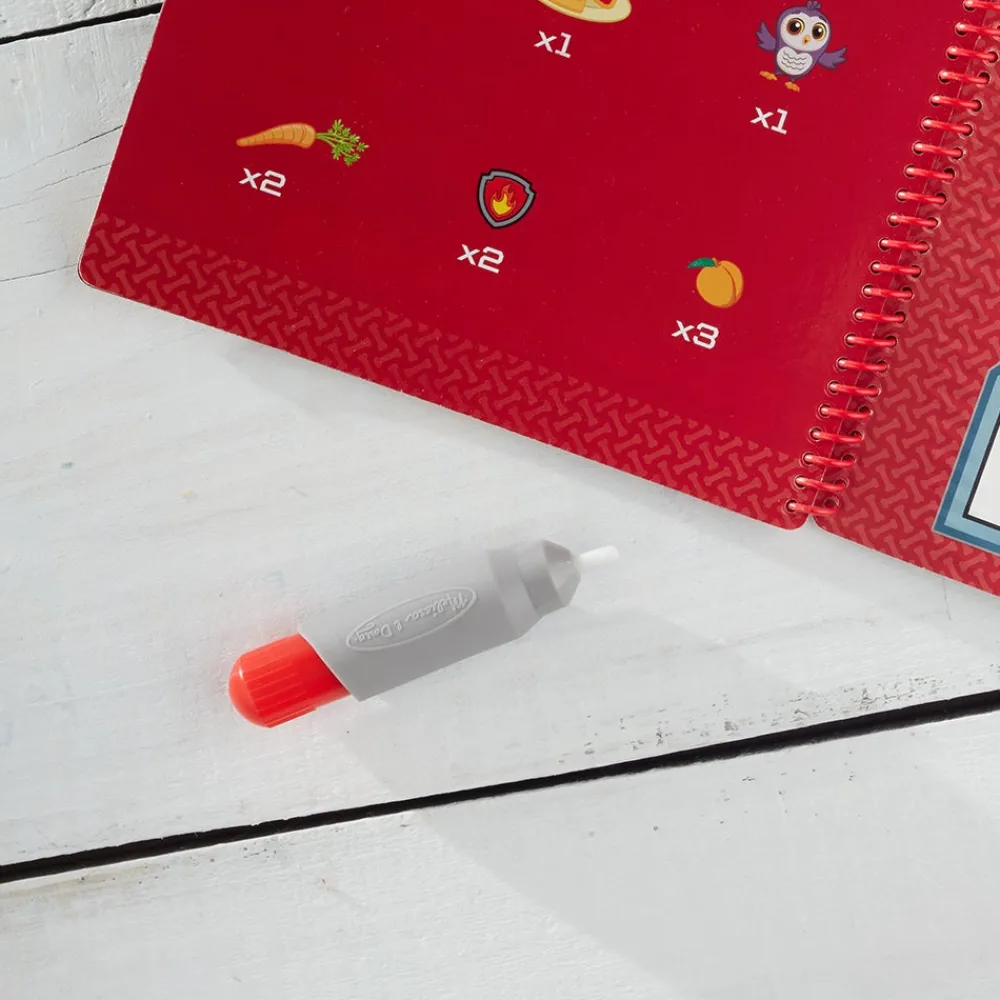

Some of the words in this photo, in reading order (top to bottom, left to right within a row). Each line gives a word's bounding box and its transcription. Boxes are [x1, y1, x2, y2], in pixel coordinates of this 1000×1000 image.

[534, 30, 572, 59] x1
[750, 106, 788, 135] x1
[239, 168, 286, 197] x2
[457, 244, 504, 274] x2
[671, 320, 720, 350] x3
